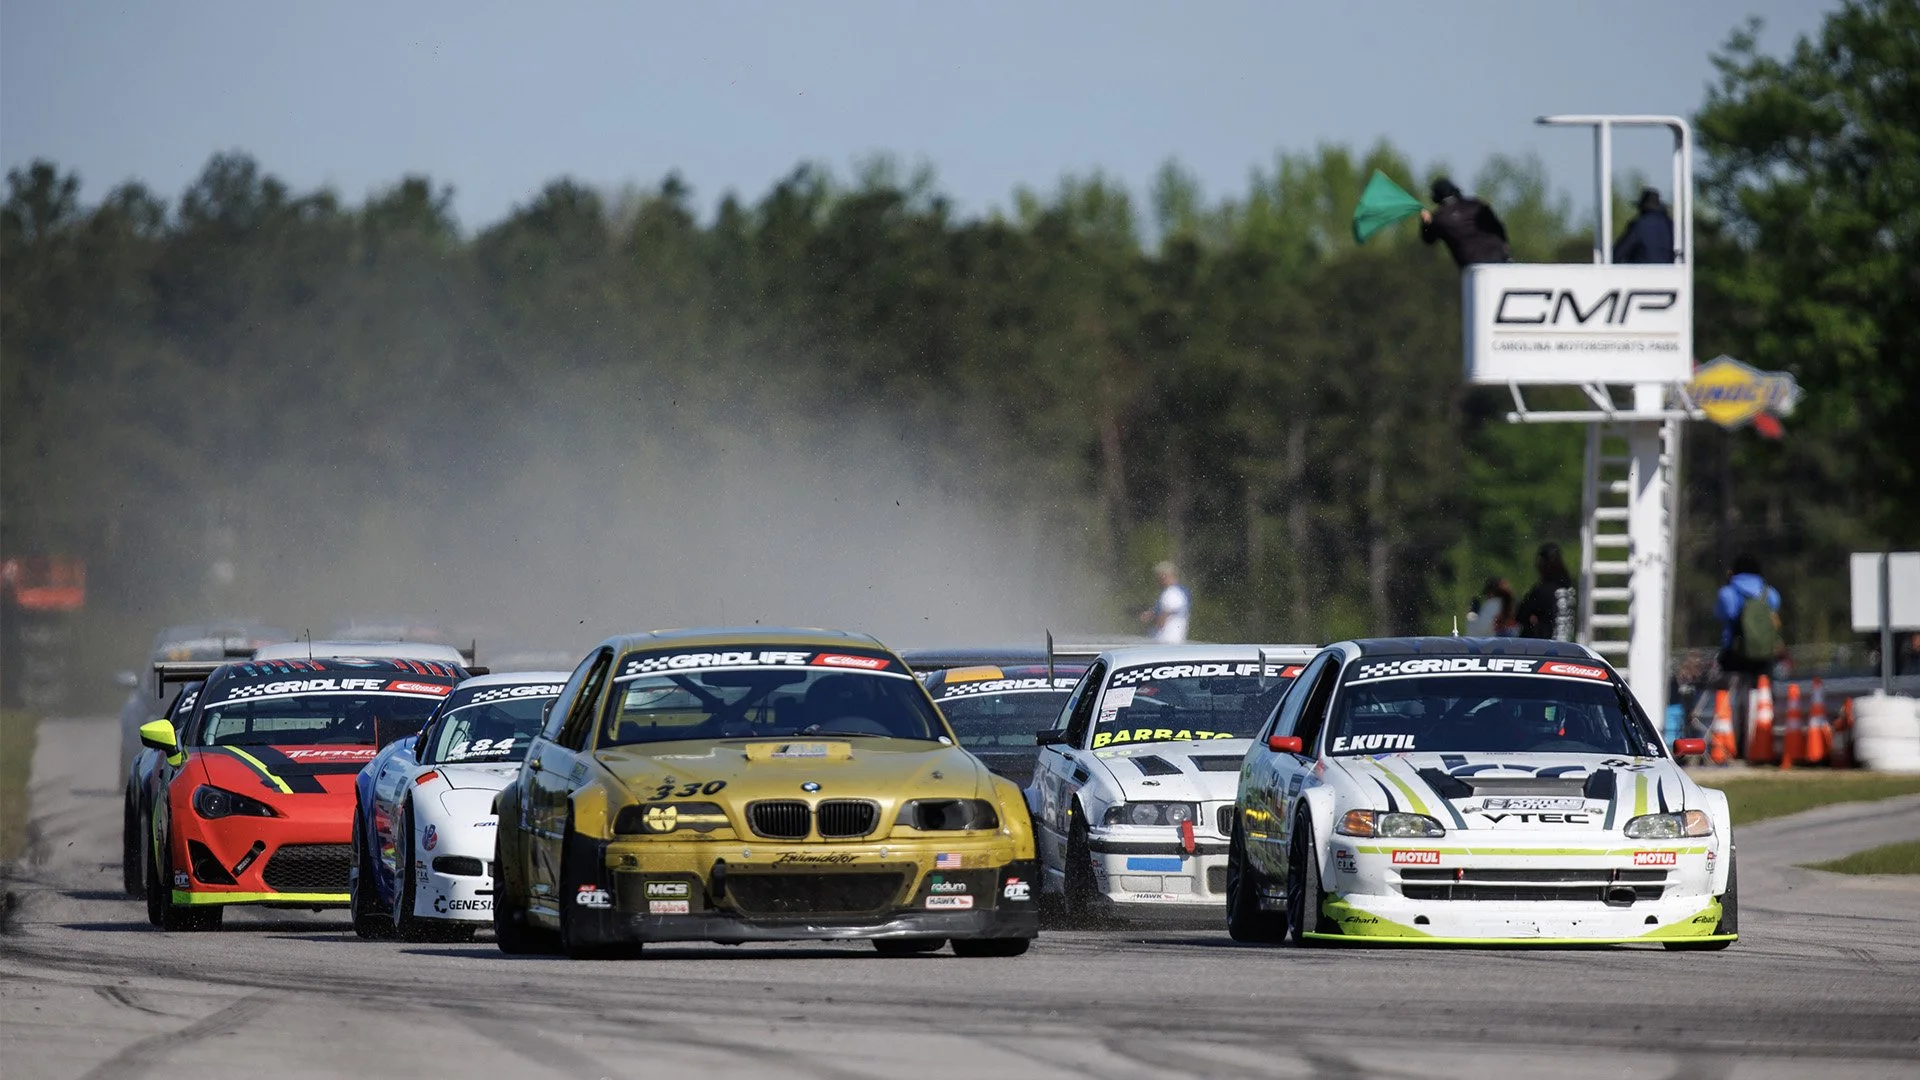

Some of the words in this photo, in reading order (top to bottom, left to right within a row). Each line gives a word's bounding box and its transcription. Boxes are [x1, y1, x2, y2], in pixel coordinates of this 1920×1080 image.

[1493, 288, 1679, 325] CMP
[667, 651, 812, 667] GRIDLIFE
[1400, 658, 1537, 674] GRIDLIFE
[1151, 663, 1284, 680] GRIDLIFE
[264, 678, 386, 694] GRIDLIFE
[1332, 733, 1416, 752] E.KUTIL
[647, 780, 727, 801] 330
[1481, 813, 1589, 824] VTEC
[1393, 851, 1439, 864] MOTUL
[1636, 853, 1676, 865] MOTUL
[647, 883, 688, 895] MCS
